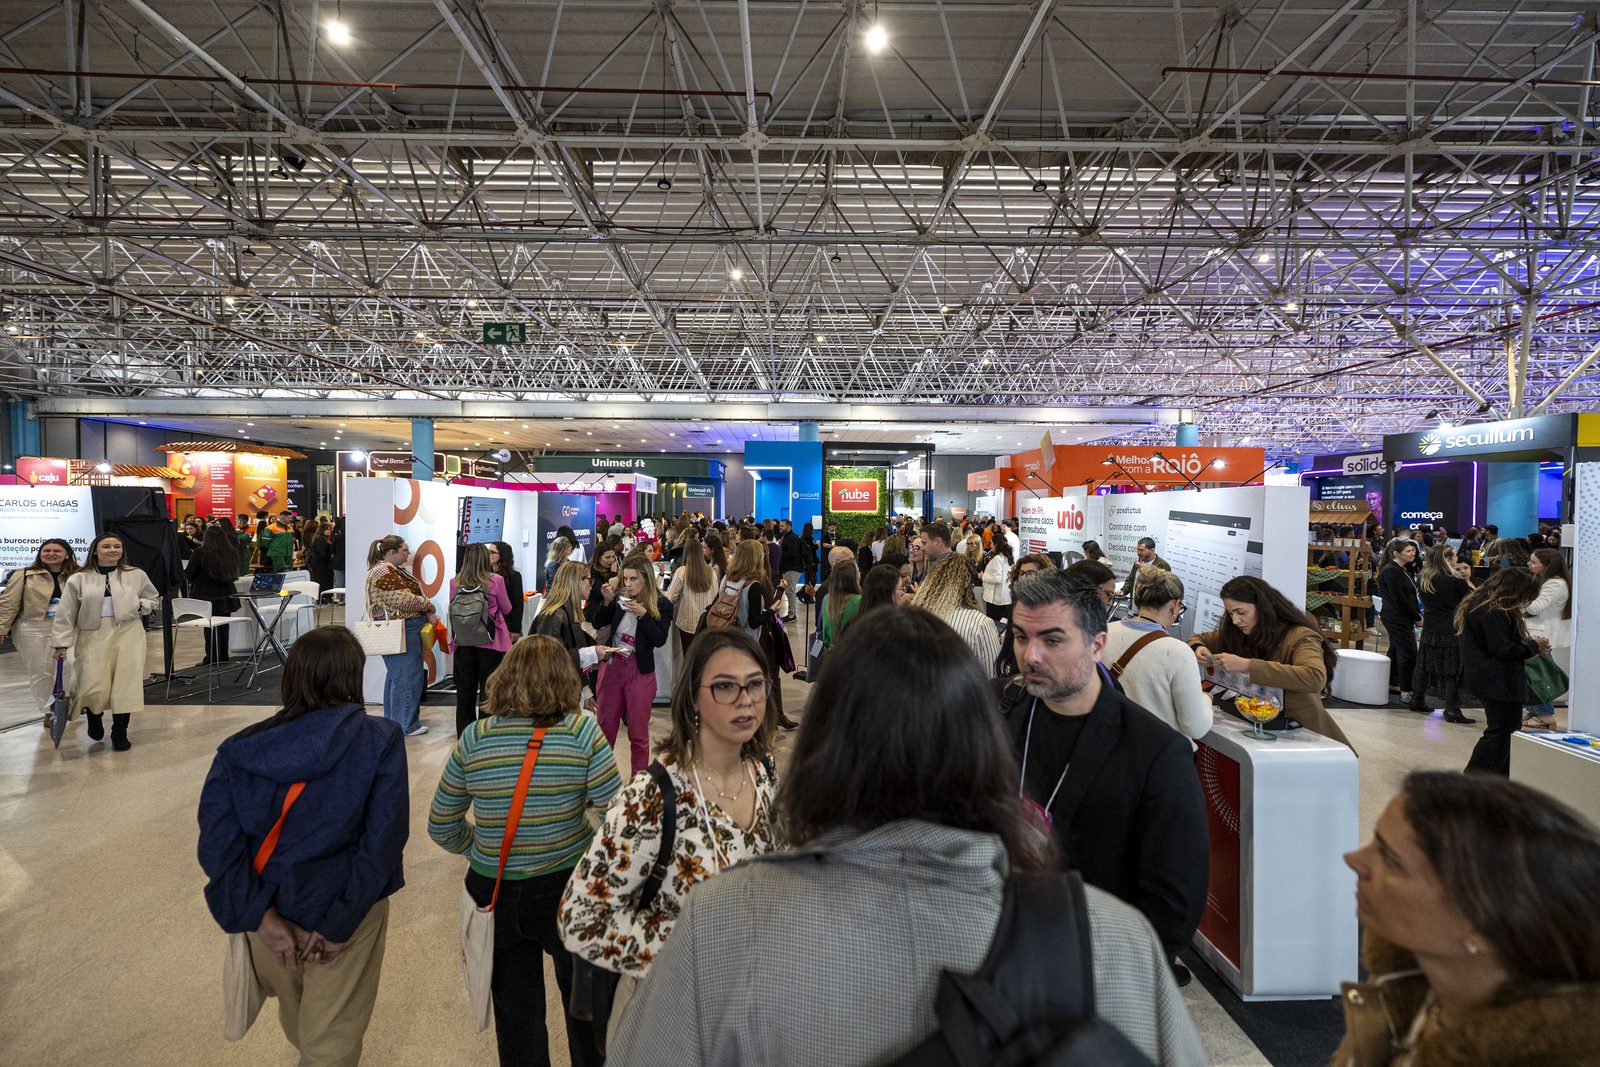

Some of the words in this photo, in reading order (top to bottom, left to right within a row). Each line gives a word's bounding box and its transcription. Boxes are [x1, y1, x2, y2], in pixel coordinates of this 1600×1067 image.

[1445, 427, 1534, 449] secullum
[592, 458, 633, 468] Unimed
[1116, 455, 1150, 465] Melhor
[1347, 456, 1396, 472] sólide
[1123, 466, 1142, 474] com
[1145, 466, 1151, 474] a
[38, 473, 59, 484] caju
[841, 488, 870, 500] nube
[0, 499, 37, 507] CARLOS
[40, 499, 79, 508] CHAGAS
[1326, 500, 1357, 510] olivas
[1116, 507, 1142, 515] predictus
[1401, 511, 1443, 521] começa
[462, 496, 473, 545] Optum
[1021, 516, 1041, 524] transforme
[1041, 516, 1054, 525] dados
[1057, 503, 1084, 531] unio
[1108, 523, 1133, 531] Contrate
[1108, 533, 1123, 541] mais
[1123, 532, 1160, 543] informo.
[0, 545, 29, 553] roteção
[1108, 543, 1127, 552] Decida
[1108, 554, 1122, 562] mais
